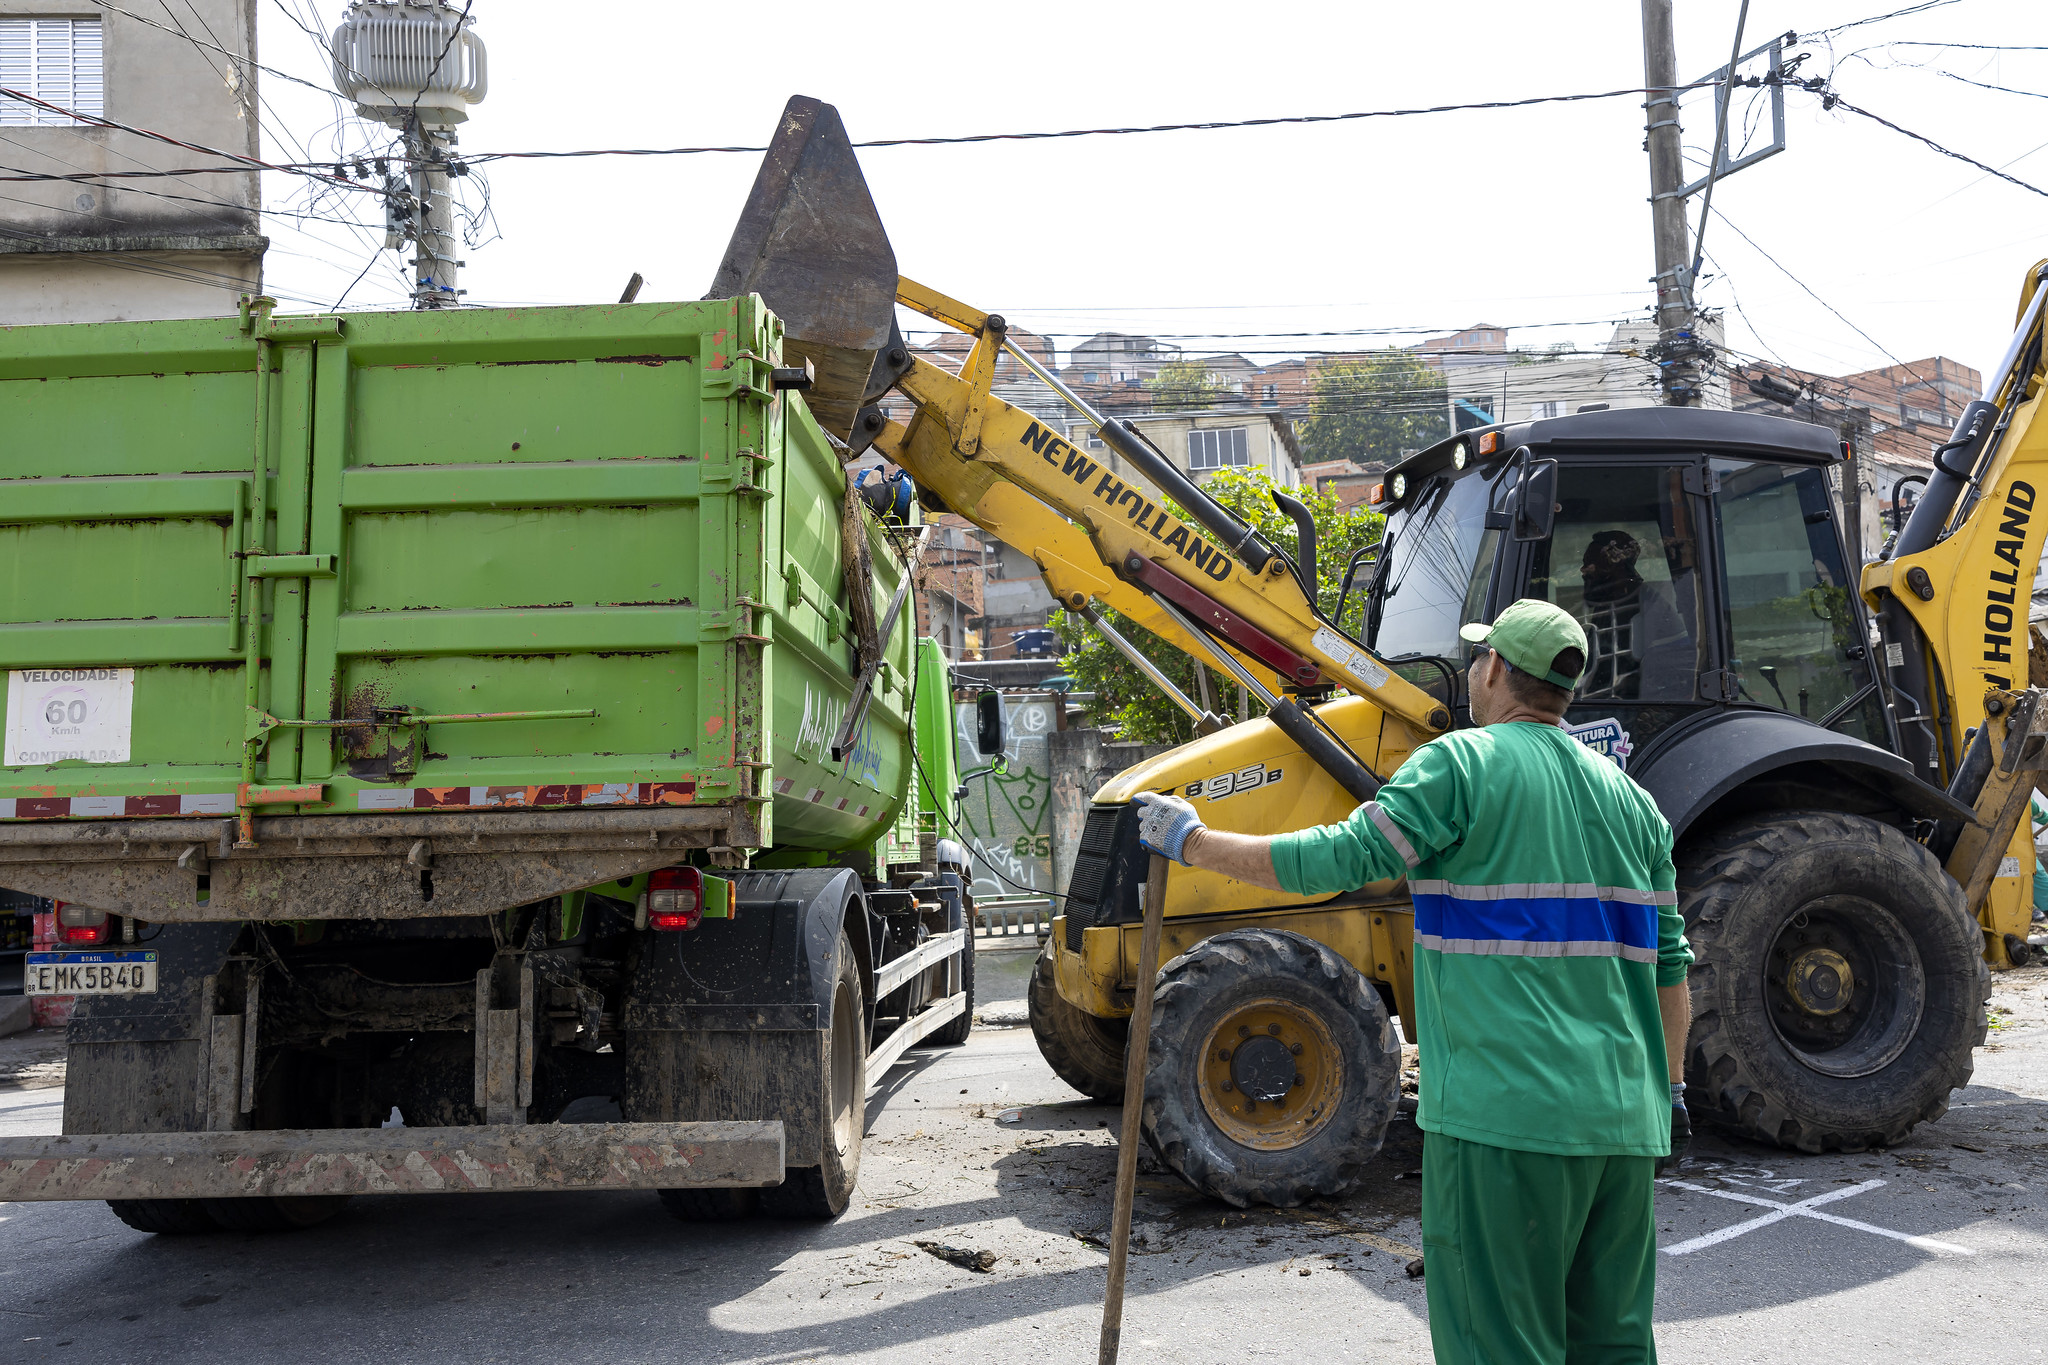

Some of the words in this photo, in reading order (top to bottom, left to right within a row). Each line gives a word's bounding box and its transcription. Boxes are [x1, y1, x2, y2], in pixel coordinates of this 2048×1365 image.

[1020, 421, 1097, 484] NEW
[1093, 473, 1233, 582] HOLLAND
[1984, 480, 2036, 663] HOLLAND
[22, 669, 118, 682] VELOCIDADE
[46, 699, 87, 725] 60
[51, 726, 80, 735] Km/h
[1588, 740, 1608, 754] EU
[19, 749, 118, 762] CONTROLADA
[39, 966, 143, 990] EMK5B40
[27, 984, 36, 992] BR
